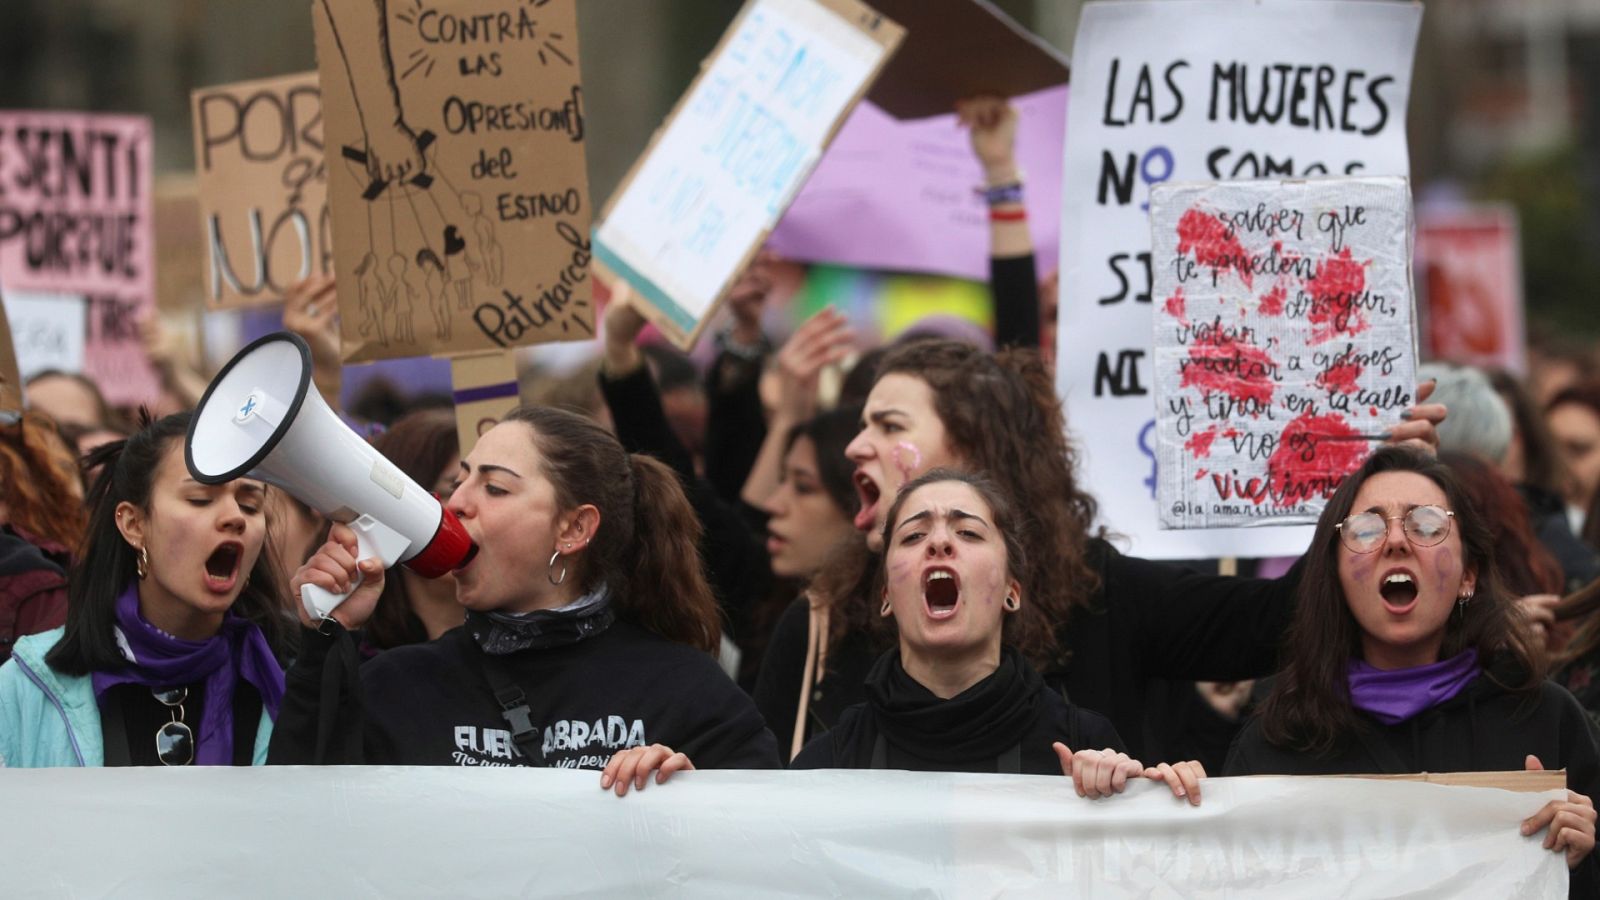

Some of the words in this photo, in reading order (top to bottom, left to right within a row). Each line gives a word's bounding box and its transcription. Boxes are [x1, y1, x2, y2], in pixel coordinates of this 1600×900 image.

[418, 7, 537, 44] CONTRA
[458, 52, 502, 77] LAS
[1103, 58, 1189, 127] LAS
[1208, 60, 1395, 136] MUJERES
[471, 147, 518, 180] del
[496, 188, 580, 221] ESTADO
[1219, 202, 1304, 241] saber
[1317, 205, 1367, 254] que
[473, 221, 591, 348] Patriarcal
[1171, 250, 1198, 283] te
[1209, 246, 1316, 288] pueden
[1287, 355, 1303, 371] a
[1169, 396, 1195, 437] y
[1204, 389, 1275, 421] tirar
[1286, 392, 1320, 416] en
[1328, 389, 1352, 414] la
[1353, 384, 1411, 411] calle
[1230, 430, 1279, 460] no
[1288, 431, 1318, 462] es
[454, 715, 646, 759] FUENABRADA
[452, 751, 478, 766] No
